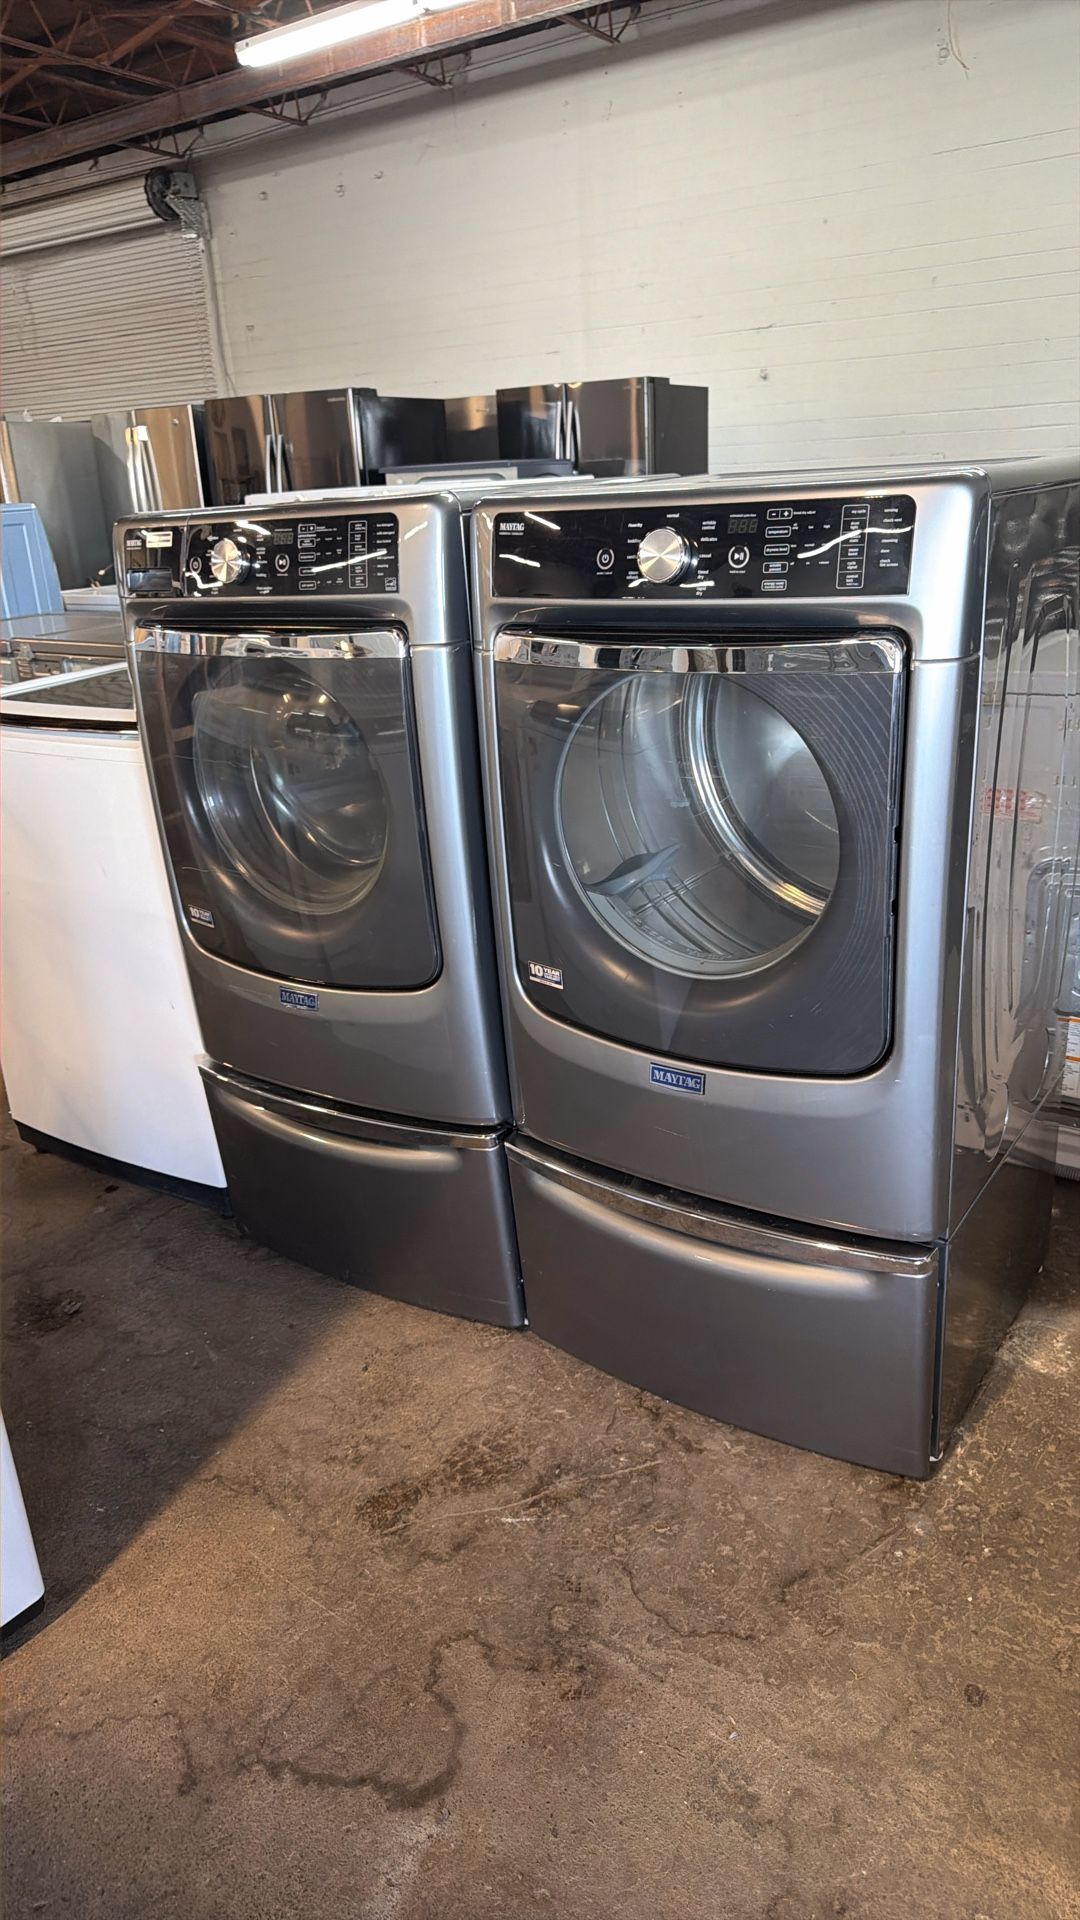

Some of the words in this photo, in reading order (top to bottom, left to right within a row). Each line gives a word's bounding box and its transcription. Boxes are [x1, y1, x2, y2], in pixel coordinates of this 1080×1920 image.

[499, 522, 525, 531] MAYTAG
[530, 963, 544, 977] 10
[281, 991, 315, 1007] MAYTAG
[653, 1069, 701, 1089] MAYTAG
